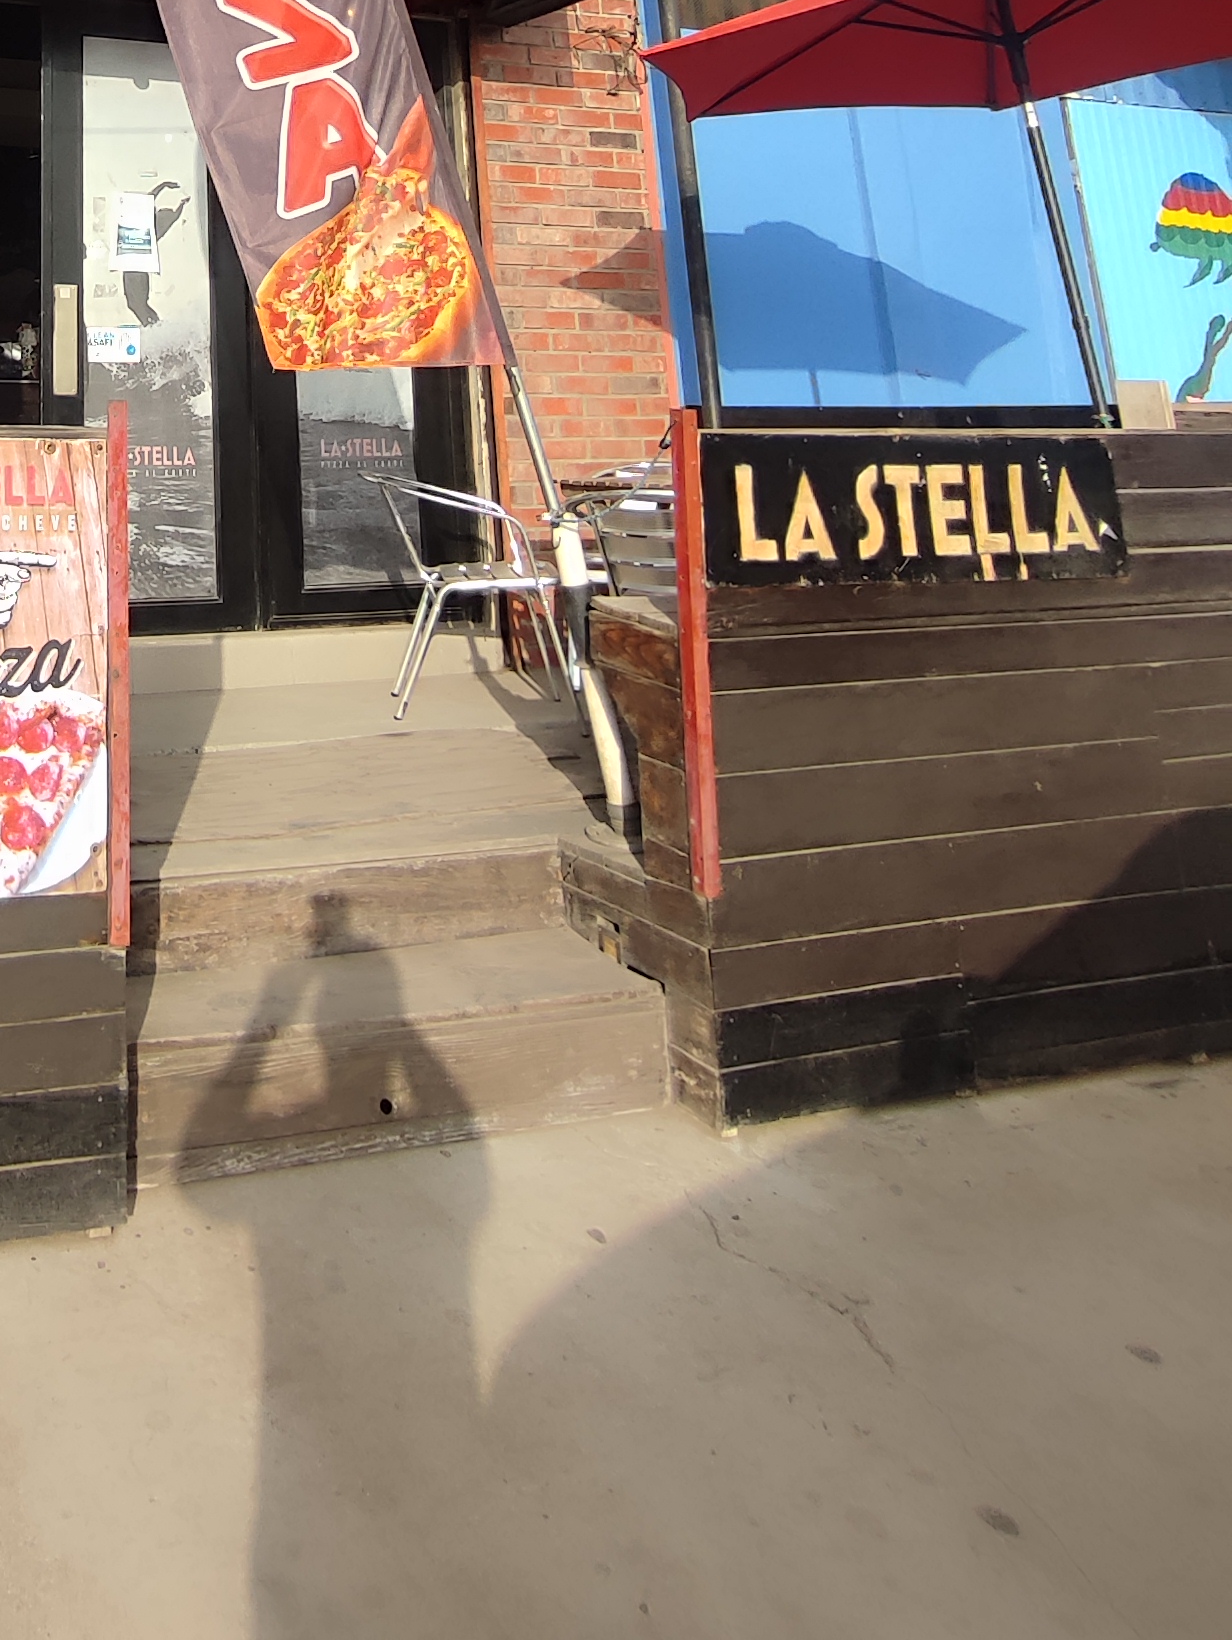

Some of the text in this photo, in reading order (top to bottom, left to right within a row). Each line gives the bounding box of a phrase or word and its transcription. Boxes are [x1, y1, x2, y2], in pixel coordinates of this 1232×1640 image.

[133, 445, 196, 466] STELLA
[320, 437, 404, 457] LA STELLA
[733, 462, 1100, 562] LA STELLA
[1, 513, 79, 532] CHEVE
